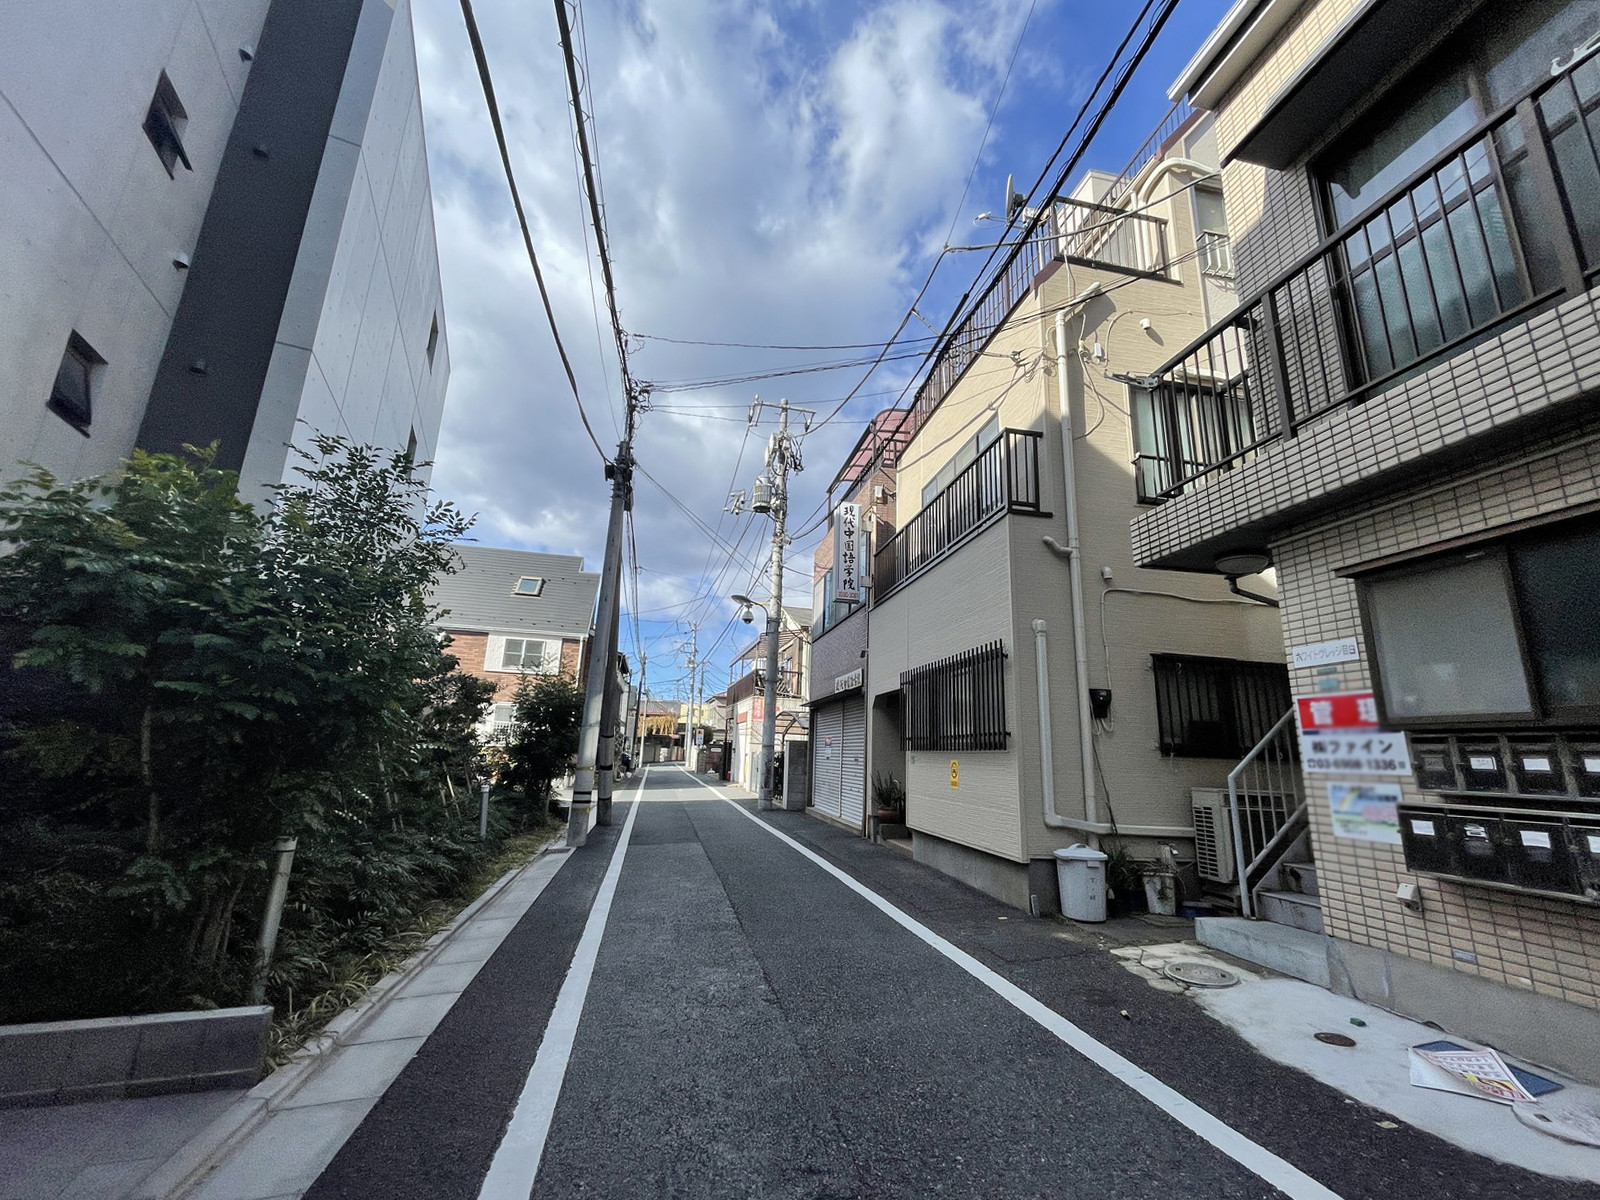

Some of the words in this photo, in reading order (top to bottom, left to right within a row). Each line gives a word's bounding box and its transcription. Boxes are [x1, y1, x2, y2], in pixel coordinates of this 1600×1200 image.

[843, 505, 855, 590] 現代中国語学院
